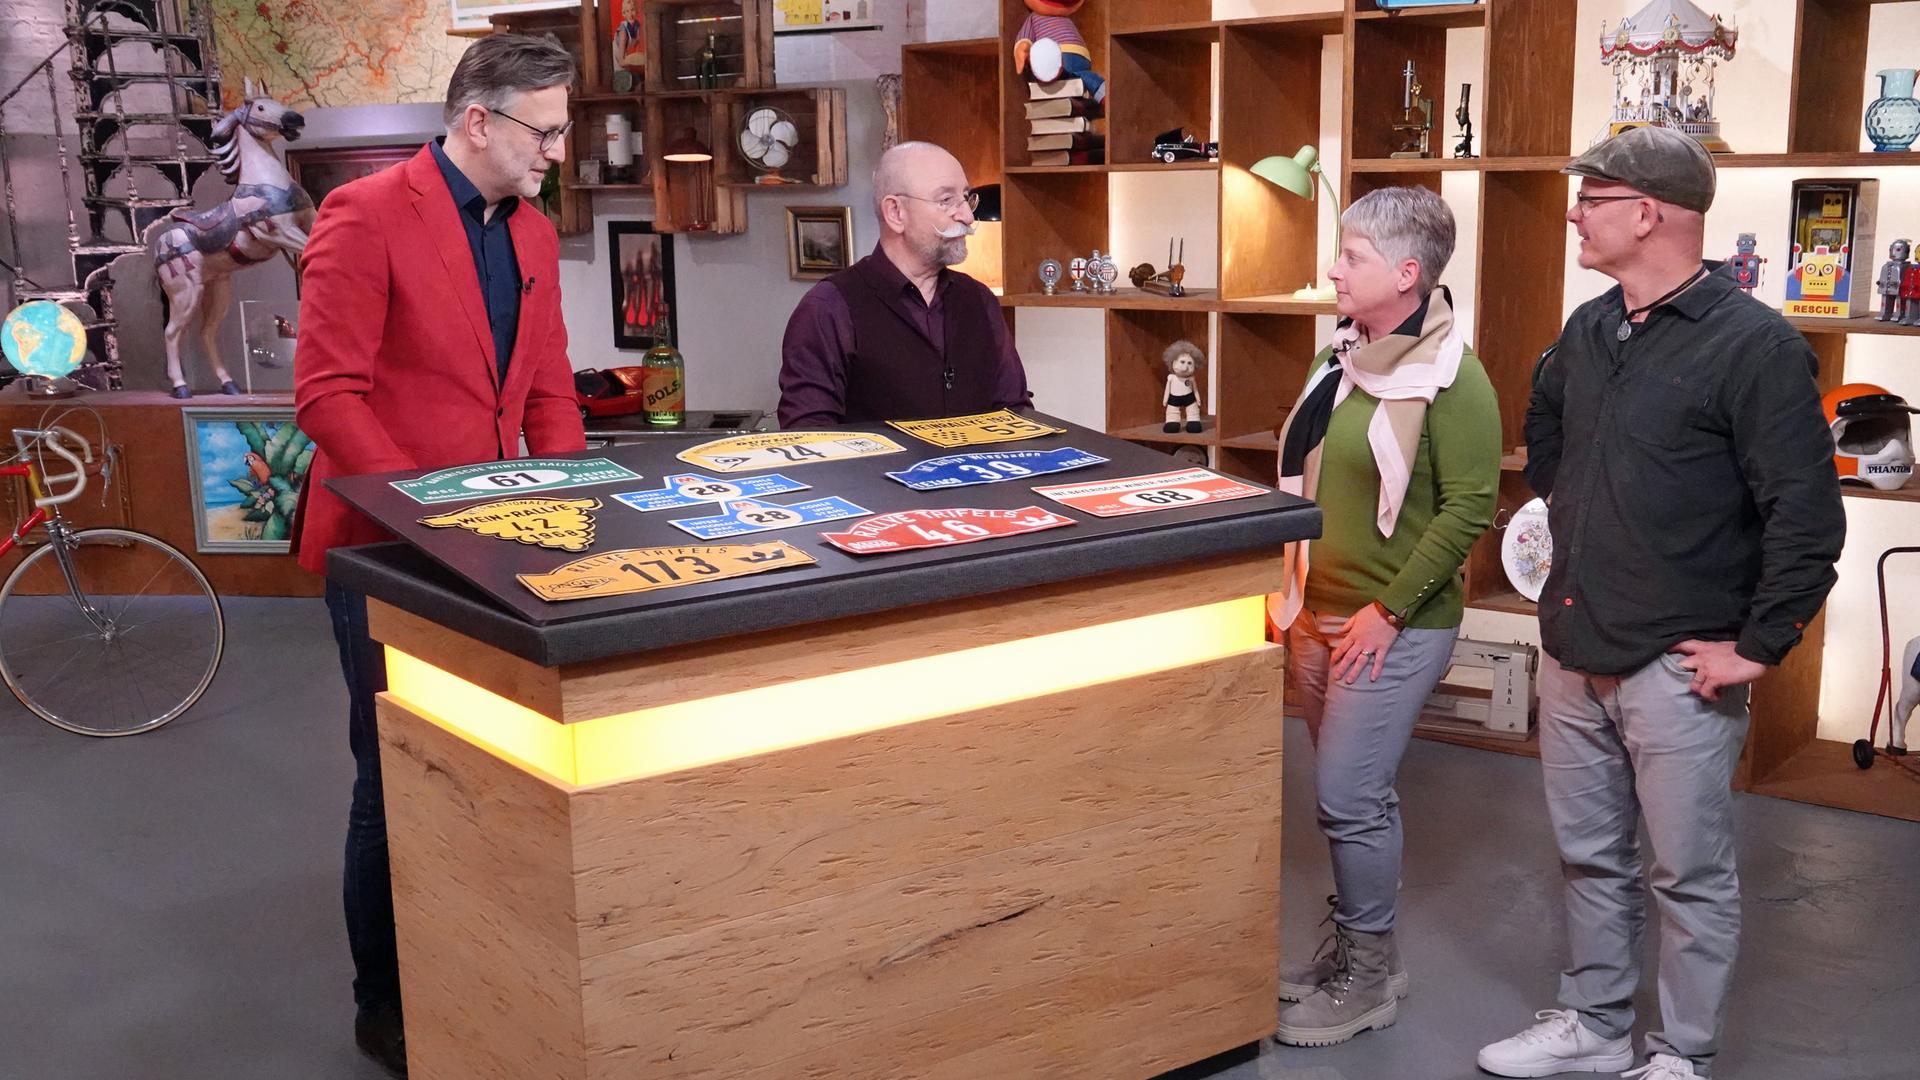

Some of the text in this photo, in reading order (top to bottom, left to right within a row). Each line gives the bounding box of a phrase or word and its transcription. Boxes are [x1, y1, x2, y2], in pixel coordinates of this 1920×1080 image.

[1793, 305, 1839, 314] RESCUE
[646, 381, 680, 406] BOLS
[907, 419, 983, 431] WEINRALLYE
[981, 422, 1041, 435] 55
[766, 445, 827, 462] 24
[958, 461, 1031, 481] 39
[1868, 465, 1911, 473] PHANTOM
[487, 472, 541, 487] 61
[688, 484, 730, 495] 28
[1136, 490, 1193, 503] 68
[457, 503, 571, 524] WEIN RALLYE
[464, 500, 549, 515] NATIONALE
[746, 510, 790, 522] 28
[853, 509, 1018, 538] RALLYE TRIFELS
[510, 518, 559, 531] 42
[907, 520, 990, 542] 46
[566, 547, 728, 572] RALLYE TRIFELS
[620, 556, 720, 584] 173
